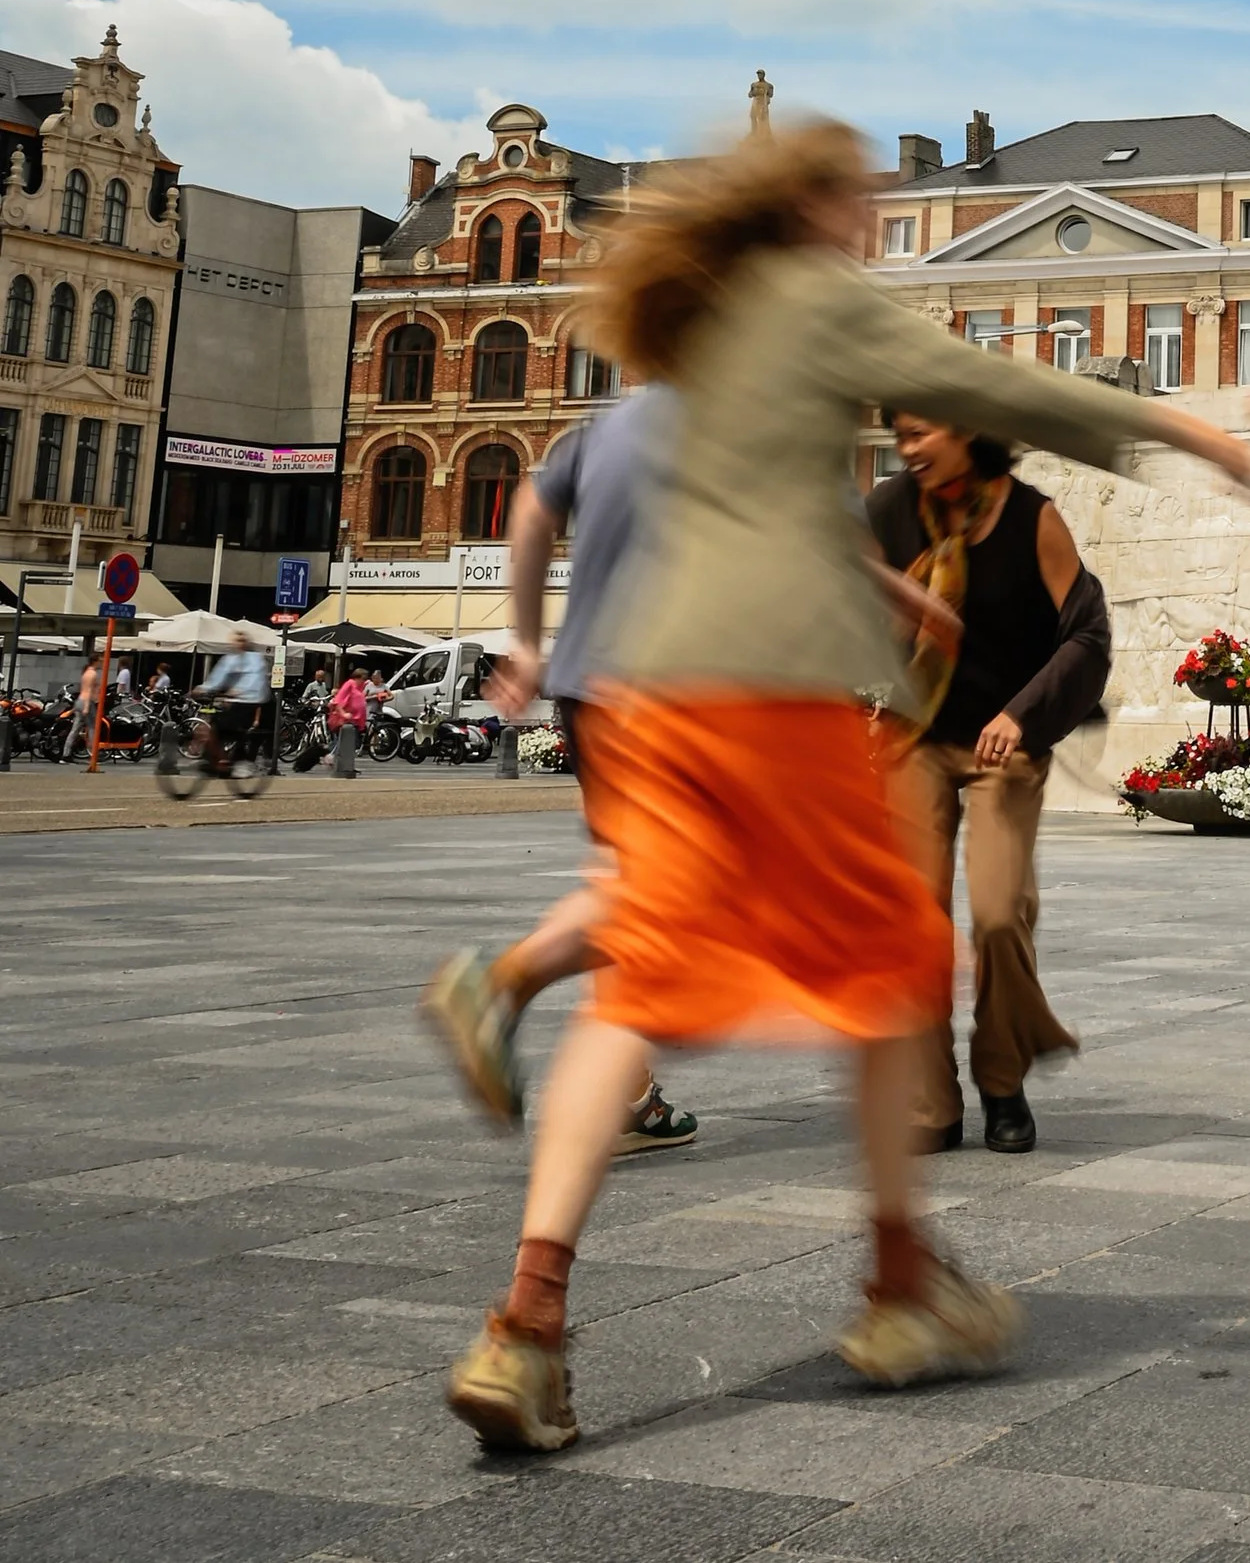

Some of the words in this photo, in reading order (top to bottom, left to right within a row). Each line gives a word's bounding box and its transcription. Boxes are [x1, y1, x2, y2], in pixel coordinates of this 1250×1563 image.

[187, 264, 222, 285] HET
[226, 273, 285, 297] DEPOT
[168, 441, 233, 458] INTERGALACTIC
[233, 449, 265, 462] LOVERS
[349, 570, 379, 578] STELLA
[389, 570, 420, 578] ARTOIS
[465, 566, 501, 580] PORT
[547, 569, 571, 578] TELLA
